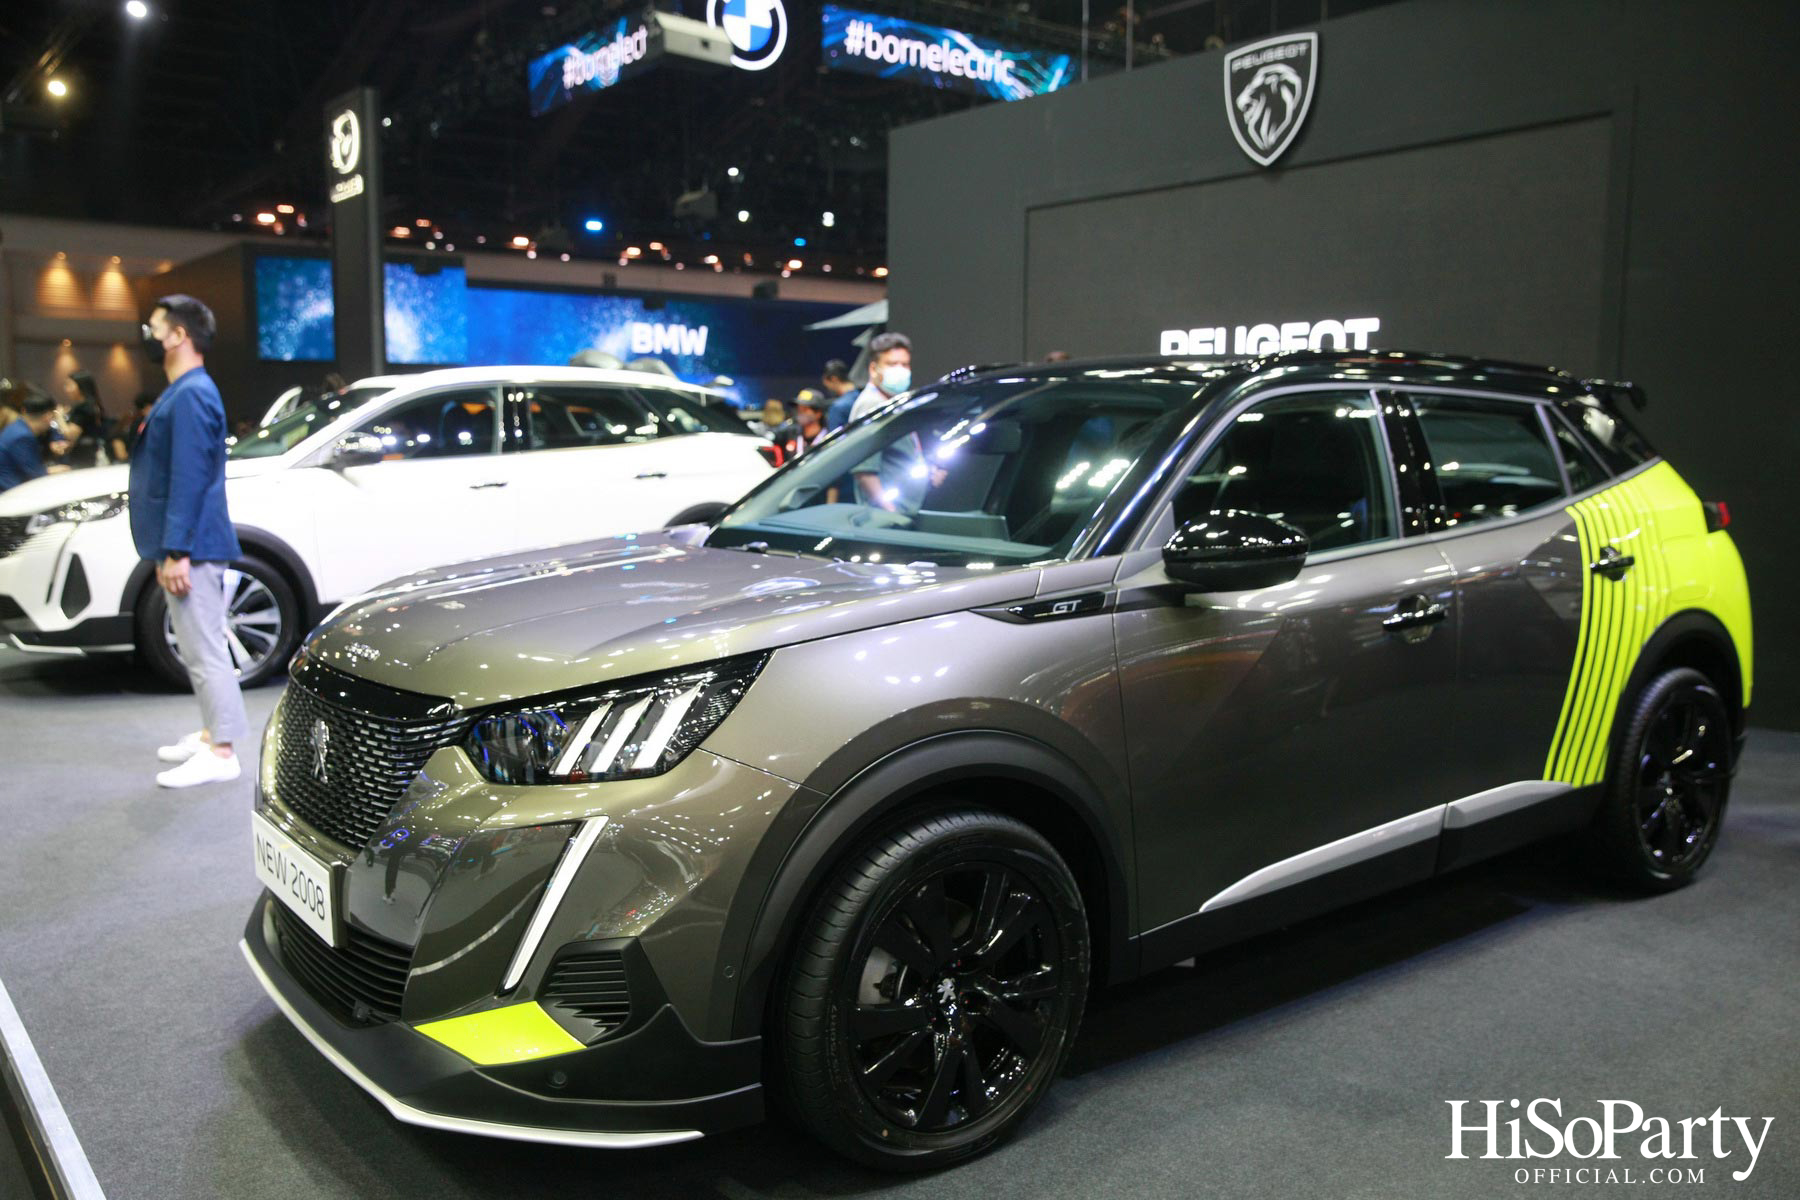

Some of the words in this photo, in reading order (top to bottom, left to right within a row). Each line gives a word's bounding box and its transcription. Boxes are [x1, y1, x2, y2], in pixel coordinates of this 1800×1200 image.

[844, 19, 1016, 86] #bornelectric
[1231, 42, 1309, 73] PEUGEOT
[631, 322, 709, 355] BMW
[1053, 599, 1082, 614] GT
[256, 832, 288, 886] NEW
[290, 862, 326, 922] 2008
